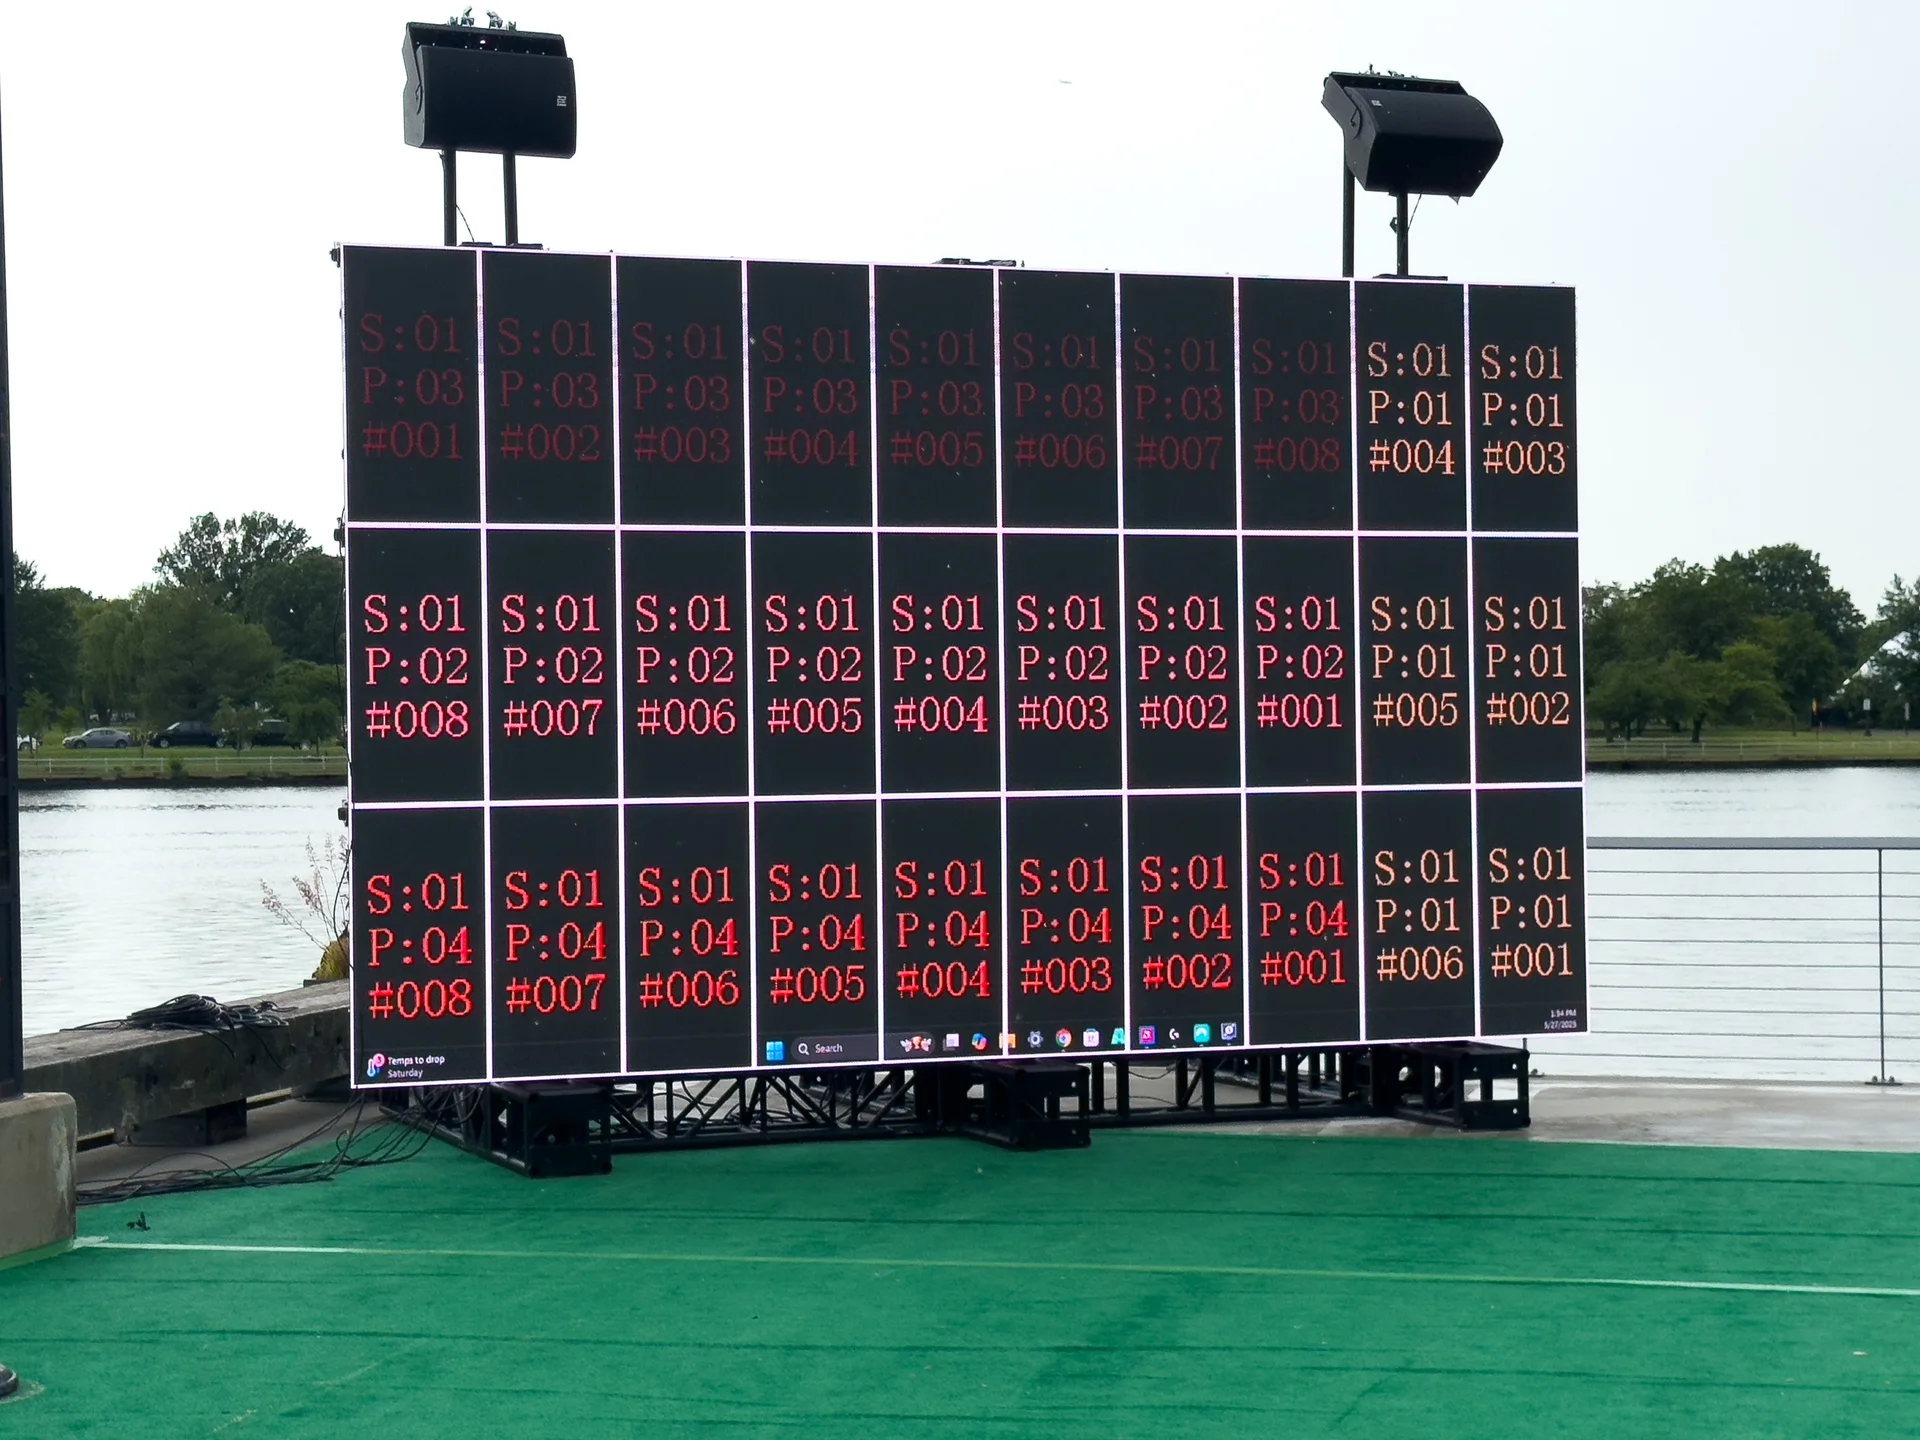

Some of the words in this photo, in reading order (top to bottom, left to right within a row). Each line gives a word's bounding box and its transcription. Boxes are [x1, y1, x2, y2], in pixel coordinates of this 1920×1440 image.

[360, 314, 461, 353] S:01
[498, 317, 596, 357] S:01
[632, 322, 727, 360] S:01
[762, 326, 855, 364] S:01
[889, 330, 977, 366] S:01
[1013, 334, 1100, 369] S:01
[1133, 337, 1221, 372] S:01
[1252, 340, 1337, 375] S:01
[1367, 341, 1451, 379] S:01
[1481, 344, 1563, 381] S:01
[364, 368, 465, 406] P:03
[502, 371, 600, 409] P:03
[636, 374, 731, 412] P:03
[766, 377, 858, 414] P:03
[892, 380, 983, 416] P:03
[1017, 383, 1105, 419] P:03
[1136, 385, 1223, 421] P:03
[1254, 388, 1341, 423] P:03
[1370, 390, 1452, 427] P:01
[1483, 392, 1564, 429] P:01
[363, 422, 463, 460] #001
[502, 425, 600, 462] #002
[635, 427, 731, 464] #003
[765, 430, 857, 467] #004
[892, 432, 984, 467] #005
[1016, 435, 1107, 469] #006
[1137, 436, 1223, 470] #007
[1255, 438, 1342, 471] #008
[1368, 439, 1455, 476] #004
[1482, 440, 1567, 476] #003
[365, 595, 467, 634] S:01
[503, 595, 601, 634] S:01
[637, 595, 732, 634] S:01
[765, 594, 860, 634] S:01
[892, 595, 982, 633] S:01
[1017, 595, 1104, 634] S:01
[1138, 595, 1224, 633] S:01
[1256, 596, 1340, 634] S:01
[1371, 596, 1453, 633] S:01
[1485, 595, 1566, 633] S:01
[366, 647, 469, 686] P:02
[505, 646, 605, 685] P:02
[638, 646, 736, 685] P:02
[768, 647, 864, 684] P:02
[894, 647, 988, 683] P:02
[1019, 645, 1110, 683] P:02
[1141, 646, 1229, 682] P:02
[1259, 644, 1346, 680] P:02
[1372, 644, 1455, 680] P:01
[1486, 642, 1566, 679] P:01
[365, 701, 471, 740] #008
[504, 699, 605, 738] #007
[637, 698, 738, 737] #006
[768, 698, 864, 735] #005
[894, 696, 990, 734] #004
[1018, 696, 1112, 732] #003
[1140, 695, 1229, 731] #002
[1257, 694, 1344, 729] #001
[1372, 692, 1460, 728] #005
[1485, 691, 1571, 727] #002
[769, 864, 862, 903] S:01
[895, 861, 987, 900] S:01
[1021, 858, 1109, 897] S:01
[1141, 856, 1227, 894] S:01
[1260, 853, 1344, 891] S:01
[1375, 850, 1459, 886] S:01
[1488, 847, 1571, 883] S:01
[368, 873, 469, 916] S:01
[506, 870, 604, 911] S:01
[640, 868, 733, 908] S:01
[898, 911, 990, 949] P:04
[1022, 908, 1112, 946] P:04
[1143, 905, 1233, 942] P:04
[1262, 901, 1350, 938] P:04
[1376, 897, 1461, 934] P:01
[1491, 894, 1571, 930] P:01
[369, 927, 474, 968] P:04
[507, 922, 607, 963] P:04
[642, 919, 740, 957] P:04
[771, 914, 866, 954] P:04
[1021, 957, 1114, 995] #003
[1144, 953, 1233, 990] #002
[1261, 950, 1346, 987] #001
[1375, 945, 1465, 982] #006
[1490, 943, 1572, 979] #001
[507, 973, 607, 1014] #007
[640, 971, 741, 1009] #006
[771, 965, 866, 1004] #005
[897, 961, 991, 999] #004
[369, 979, 474, 1020] #008
[388, 1057, 413, 1066] Temps
[415, 1056, 424, 1064] to
[426, 1055, 445, 1065] drop
[815, 1043, 843, 1054] Search
[388, 1068, 423, 1078] Saturday
